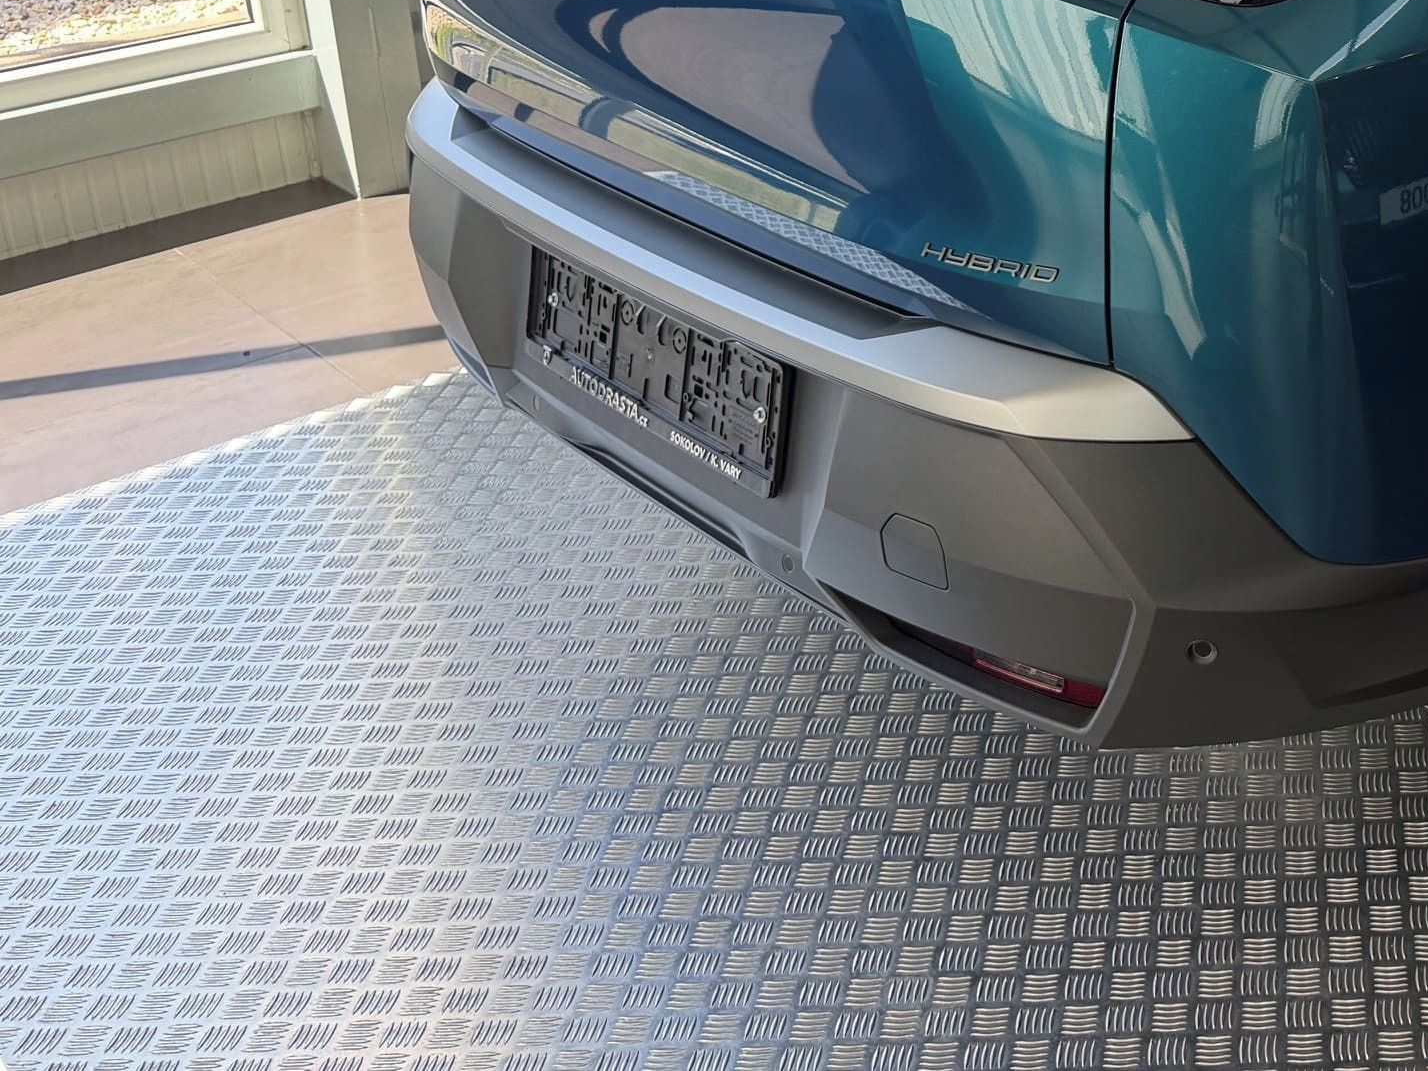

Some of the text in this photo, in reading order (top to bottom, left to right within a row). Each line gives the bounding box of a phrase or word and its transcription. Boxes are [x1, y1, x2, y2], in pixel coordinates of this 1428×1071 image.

[920, 241, 1061, 285] HYBRID
[569, 365, 648, 429] AUTODRASTA.cz
[670, 430, 706, 460] SOKOLOV
[720, 459, 742, 480] VARY
